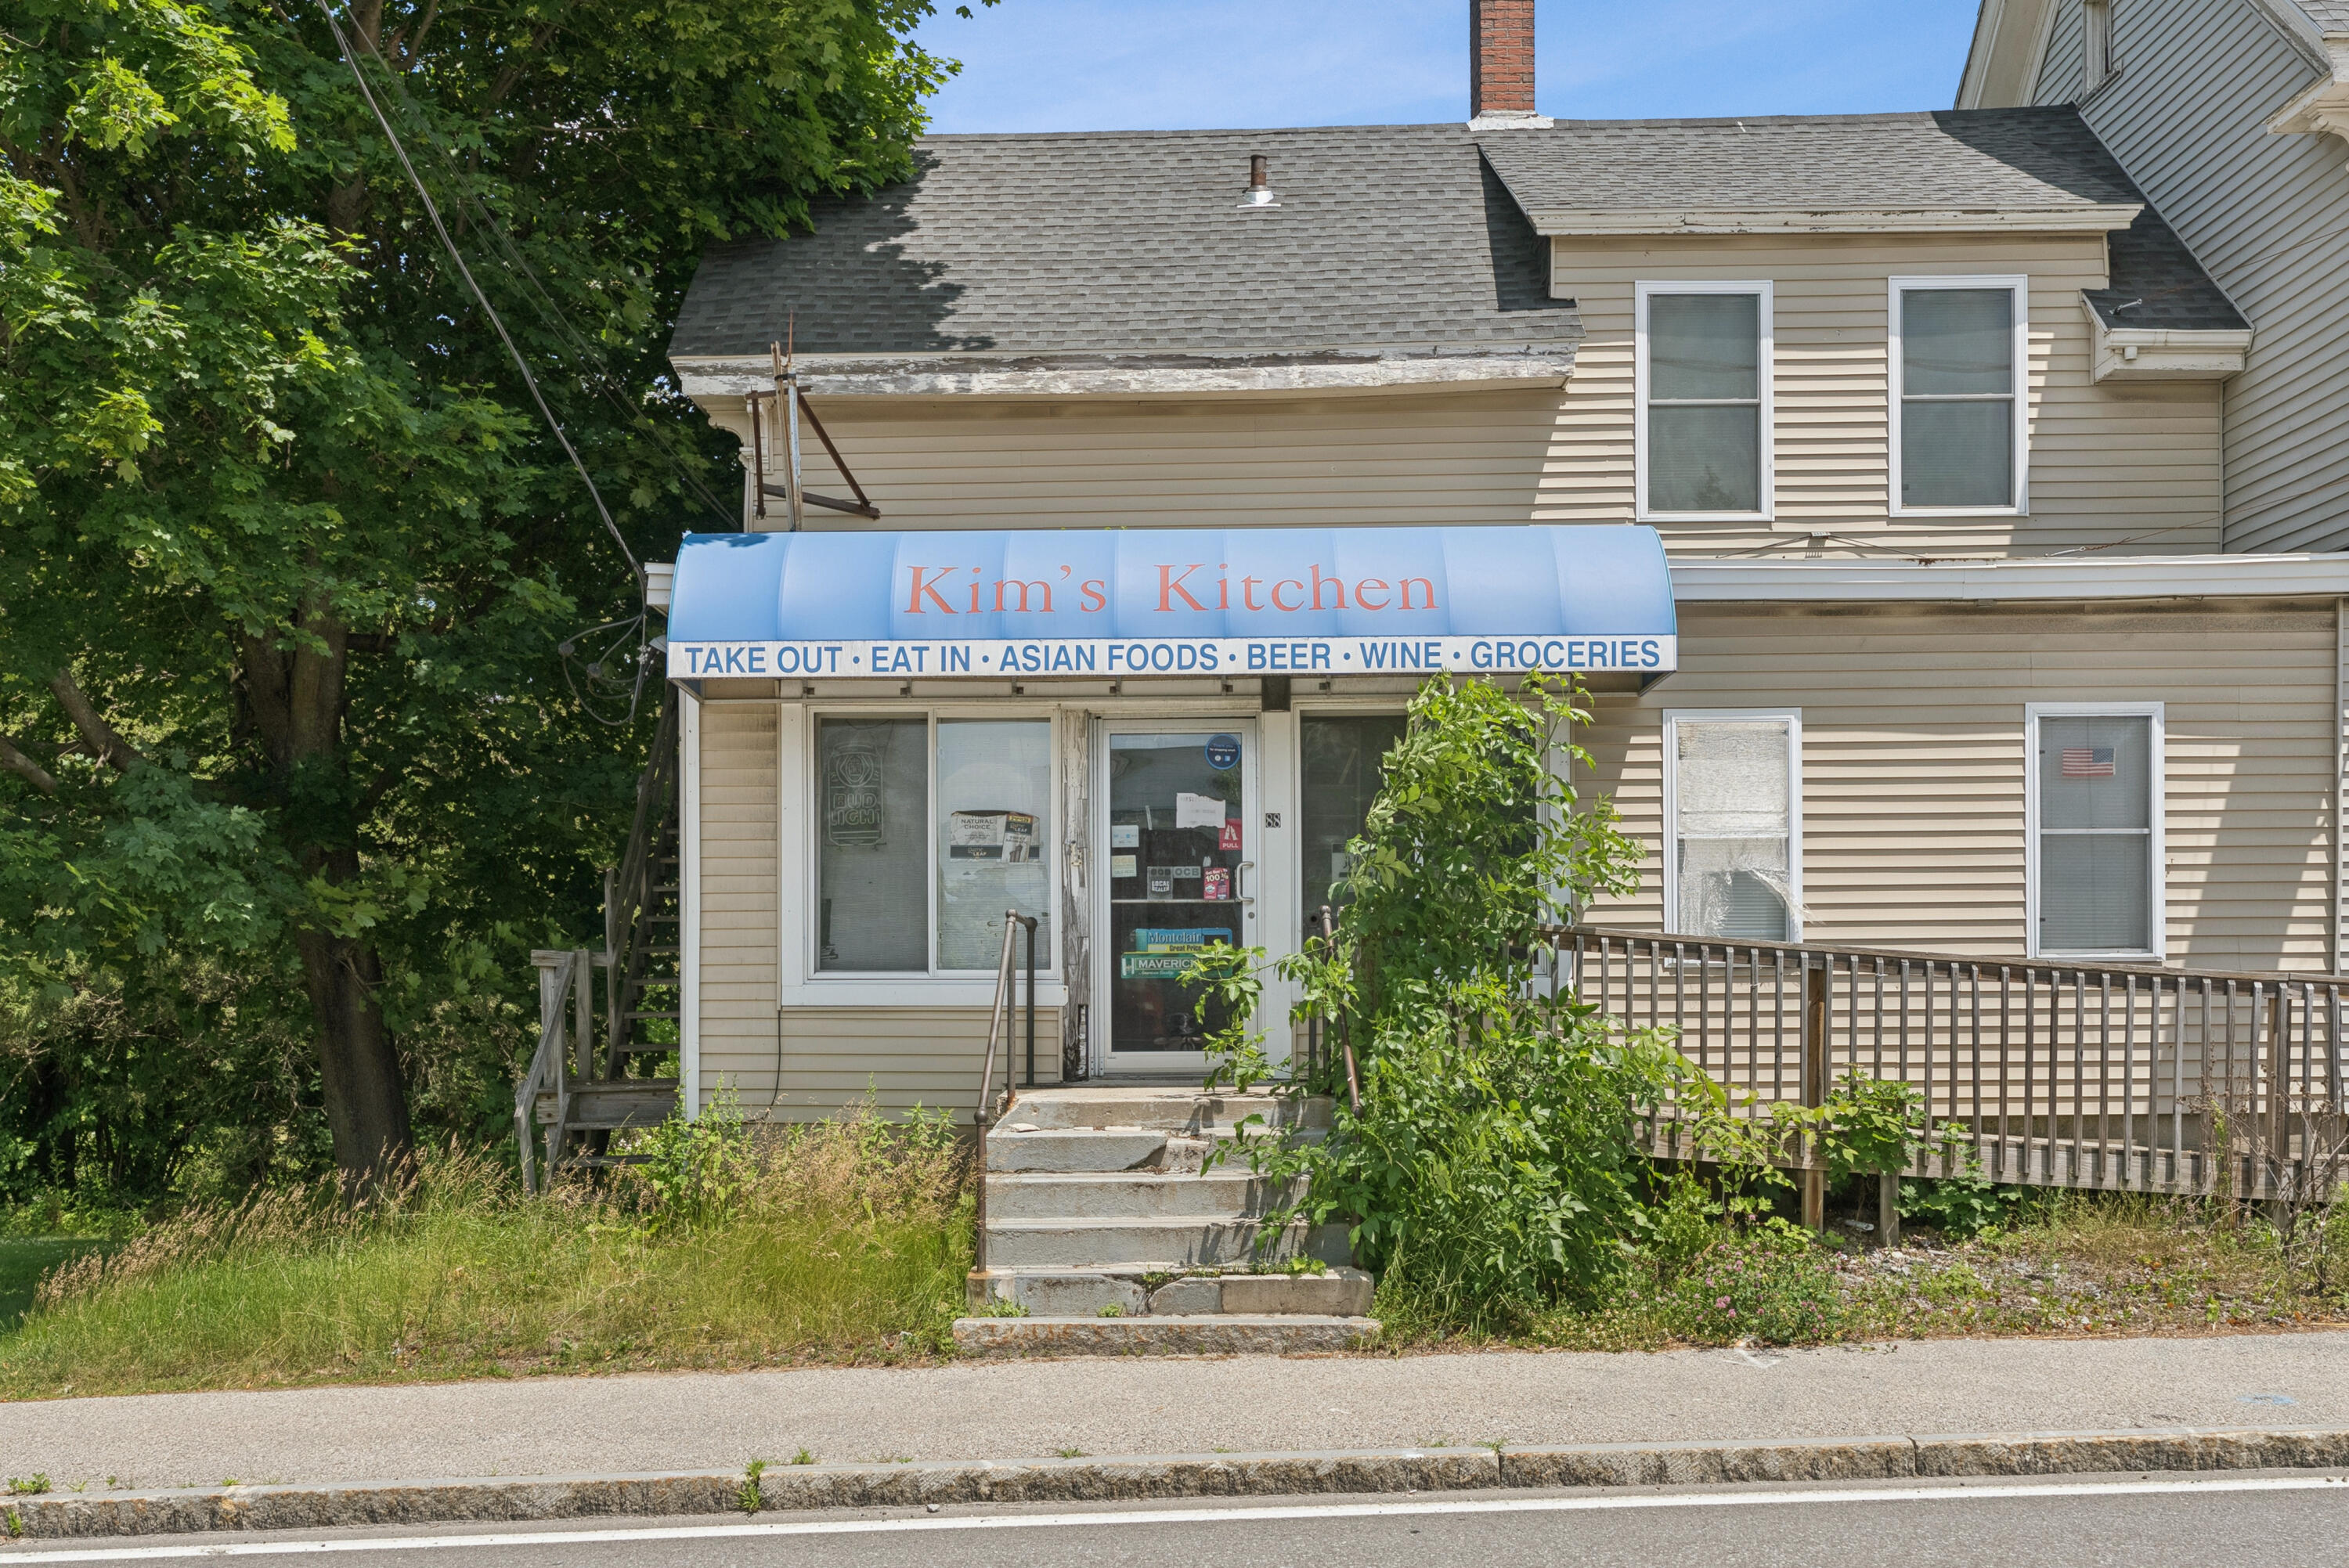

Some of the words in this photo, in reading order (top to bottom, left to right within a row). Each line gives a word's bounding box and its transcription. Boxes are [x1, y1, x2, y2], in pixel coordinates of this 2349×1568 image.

[904, 564, 1106, 615] Kim's
[1154, 563, 1439, 612] Kitchen
[685, 647, 767, 673] TAKE
[777, 646, 843, 673] OUT
[871, 646, 930, 672] EAT
[941, 644, 970, 672] IN
[999, 644, 1095, 672] ASIAN
[1108, 643, 1218, 671] FOODS
[1247, 643, 1331, 669] BEER
[1360, 641, 1442, 669] WINE
[1471, 640, 1661, 668] GROCERIES
[833, 792, 877, 809] BUD
[831, 809, 881, 826] LIGHT
[1266, 813, 1280, 827] 88
[1174, 867, 1200, 876] OCB
[1147, 932, 1203, 943] Montclair
